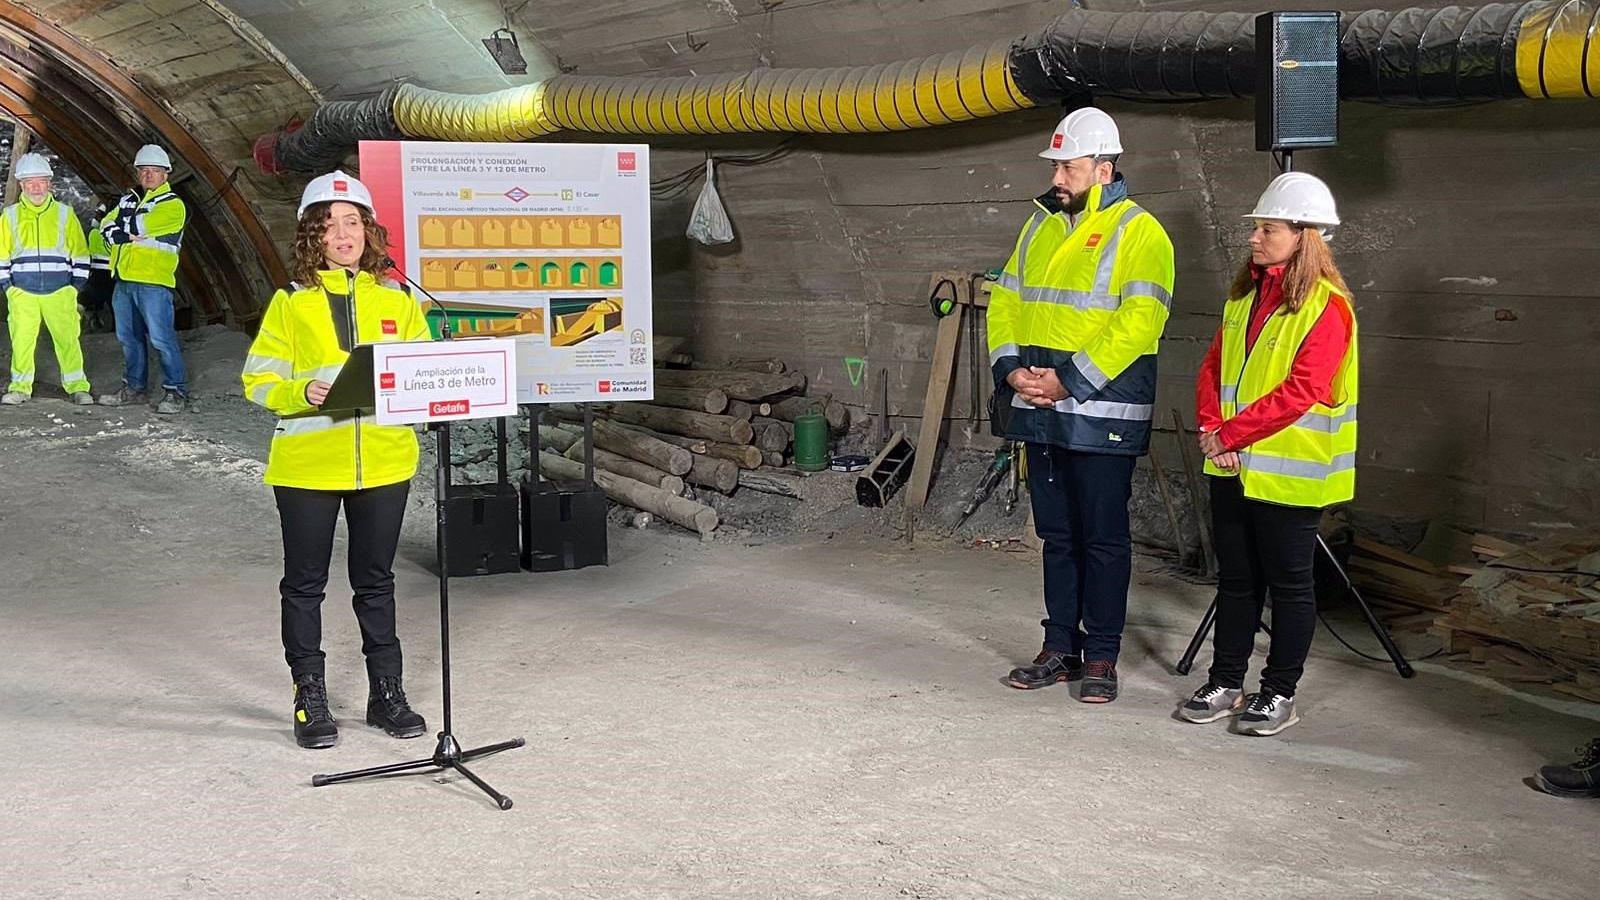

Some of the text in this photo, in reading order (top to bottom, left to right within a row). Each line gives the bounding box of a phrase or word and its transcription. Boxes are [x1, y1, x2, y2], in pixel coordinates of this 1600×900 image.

[410, 157, 476, 165] PROLONGACIÓN
[415, 366, 486, 378] Ampliación de la
[404, 376, 496, 391] Línea 3 de Metro
[433, 404, 466, 414] Getafe
